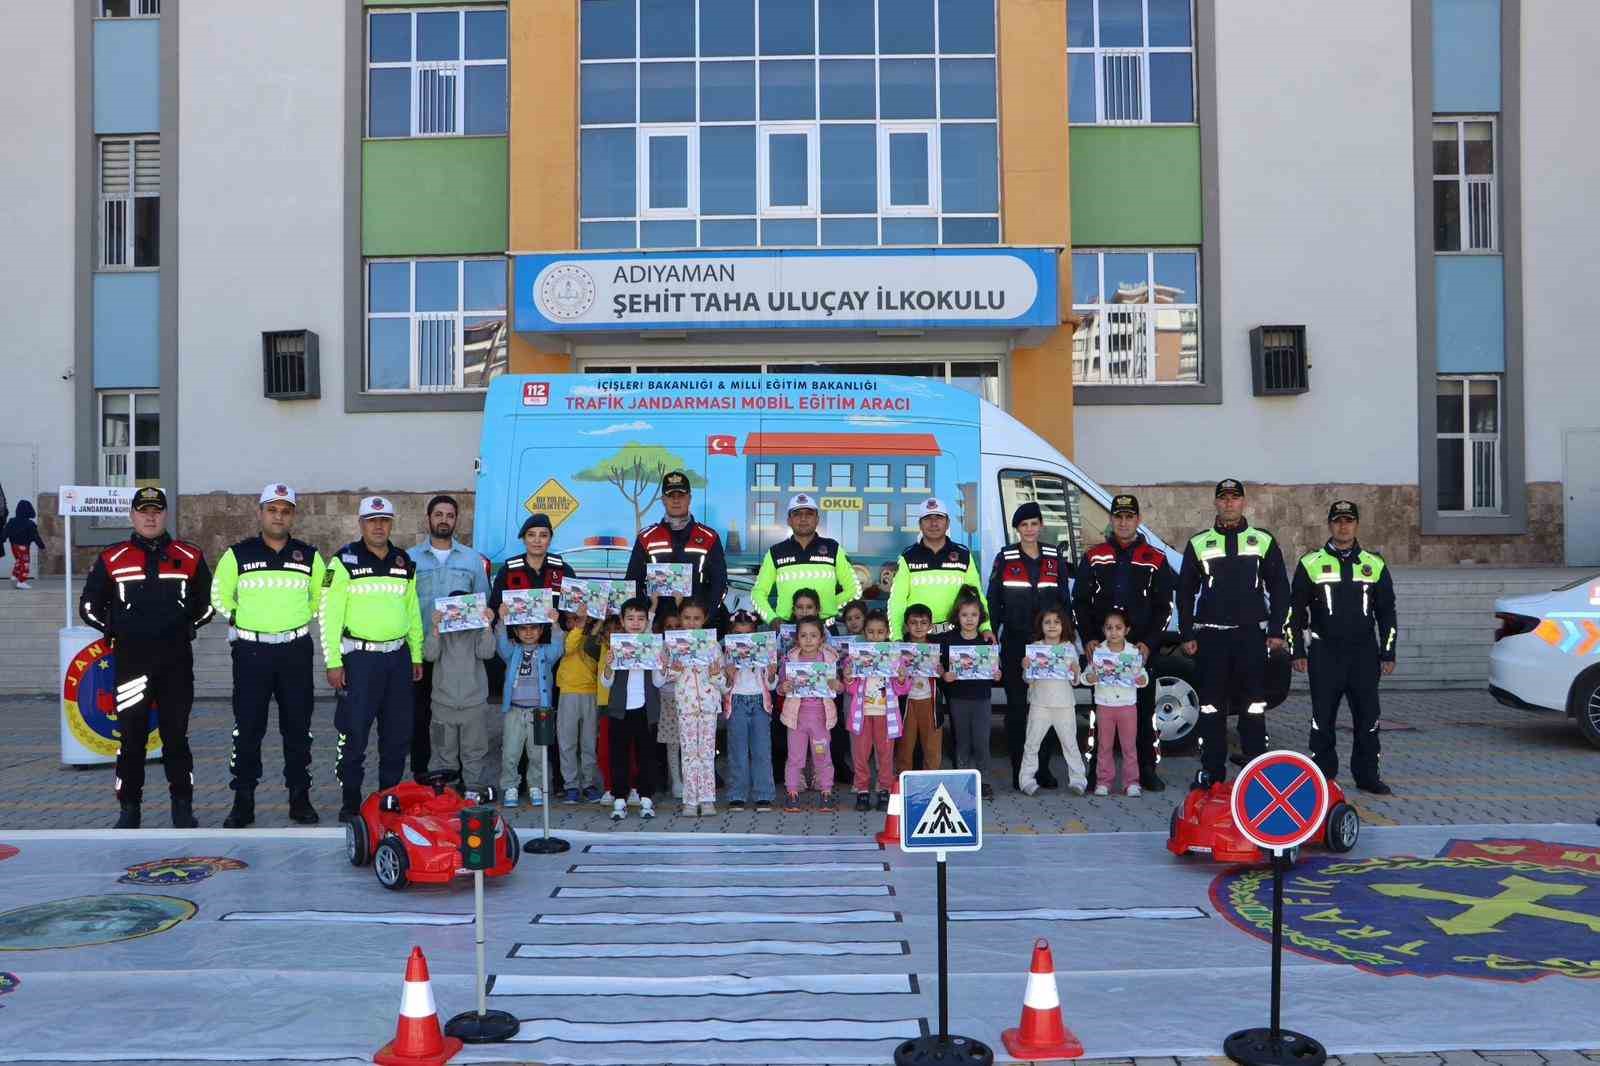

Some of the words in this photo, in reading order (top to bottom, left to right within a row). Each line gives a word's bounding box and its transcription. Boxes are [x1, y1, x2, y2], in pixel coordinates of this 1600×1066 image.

[613, 263, 736, 284] ADIYAMAN
[613, 288, 686, 319] ŞEHİT
[691, 291, 761, 312] TAHA
[768, 290, 869, 316] ULUÇAY
[877, 286, 1006, 311] İLKOKULU
[526, 384, 546, 397] 112
[648, 380, 713, 390] BAKANLIĞI
[717, 382, 726, 390] &
[730, 380, 761, 390] MİLLİ
[766, 380, 807, 390] EĞİTİM
[811, 380, 878, 391] BAKANLIĞI
[565, 393, 624, 410] TRAFİK
[628, 396, 736, 410] JANDARMASI
[741, 393, 794, 410] MOBİL
[799, 393, 855, 411] EĞİTİM
[860, 397, 911, 411] ARACI
[79, 505, 113, 513] JANDARMA
[823, 499, 860, 509] OKUL
